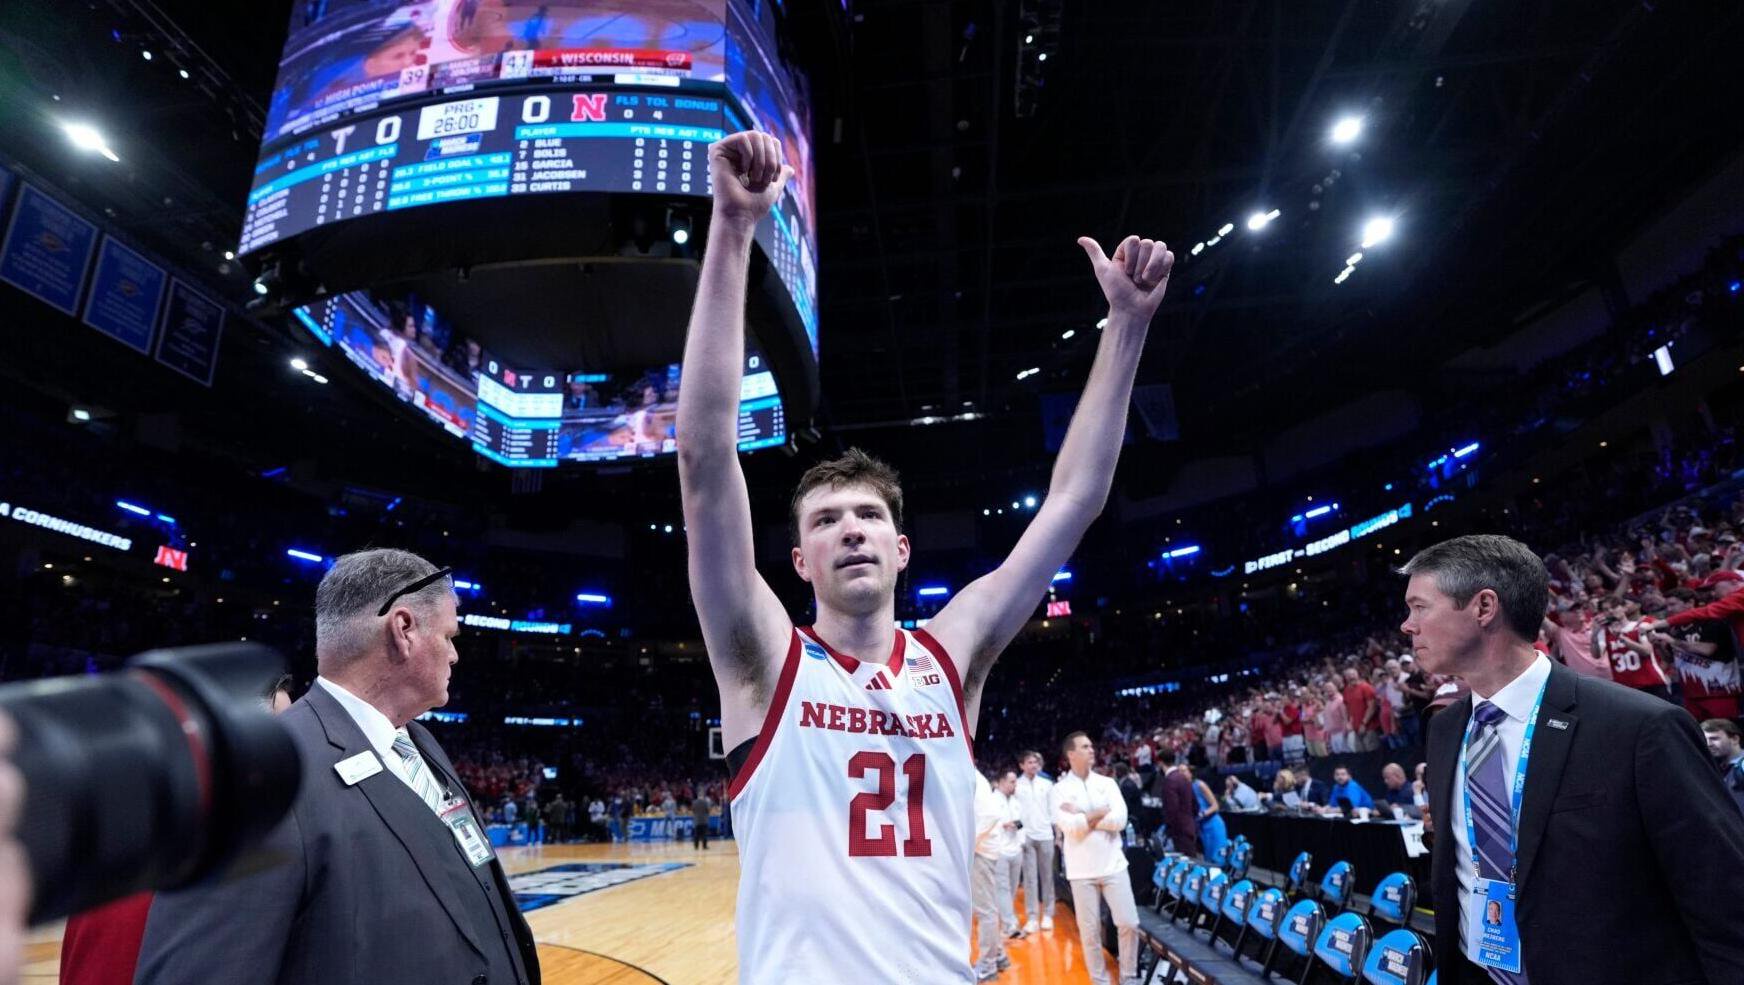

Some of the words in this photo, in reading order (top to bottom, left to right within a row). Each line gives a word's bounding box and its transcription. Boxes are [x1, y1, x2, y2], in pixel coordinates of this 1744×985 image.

[561, 53, 634, 65] WISCONSIN
[402, 69, 424, 85] 39
[444, 103, 475, 115] PRG
[571, 93, 608, 122] N
[675, 99, 718, 112] BONUS
[433, 114, 480, 134] 26:00
[331, 125, 356, 155] T
[534, 138, 561, 148] BLUE
[532, 159, 574, 170] GARCIA
[531, 170, 587, 181] JACOBSEN
[529, 181, 571, 192] CURTIS
[12, 507, 132, 551] CORNHUSKERS
[154, 545, 188, 572] N
[1258, 549, 1293, 570] FIRST
[1306, 529, 1350, 557] SECOND
[465, 614, 511, 629] SECOND
[1611, 650, 1641, 673] 30
[800, 701, 955, 739] NEBRASKA
[848, 751, 932, 857] 21
